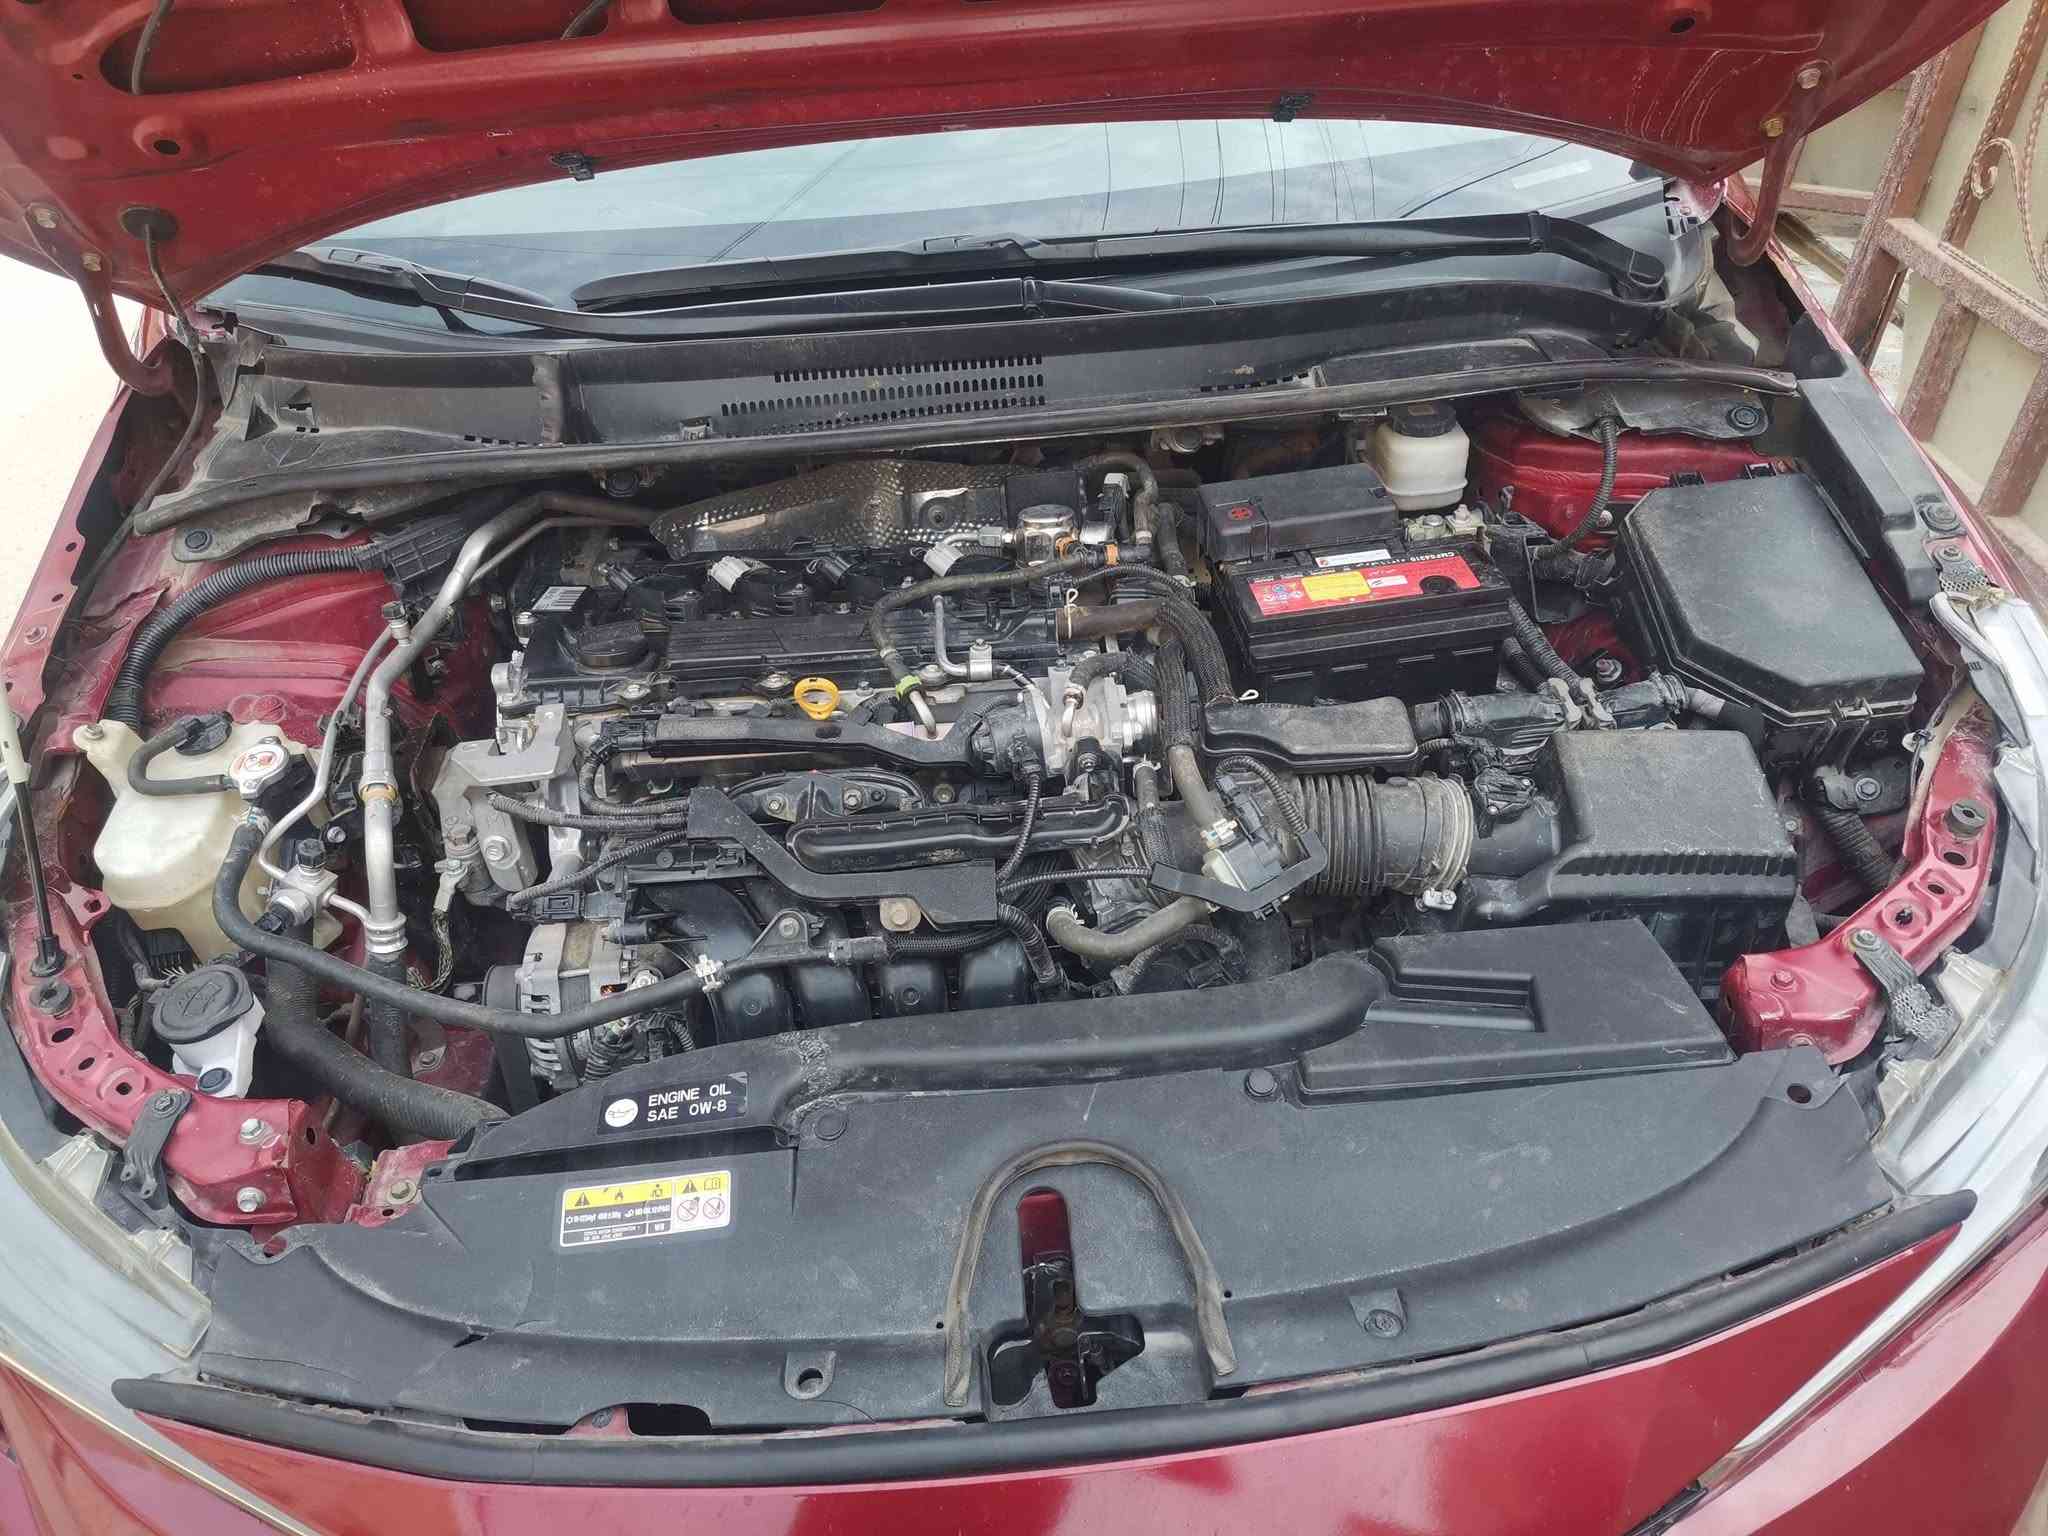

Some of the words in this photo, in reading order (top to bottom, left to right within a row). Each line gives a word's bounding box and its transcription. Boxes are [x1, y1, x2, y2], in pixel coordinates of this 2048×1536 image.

[648, 1087, 700, 1106] ENGINE
[709, 1083, 731, 1097] OIL
[647, 1106, 679, 1122] SAE
